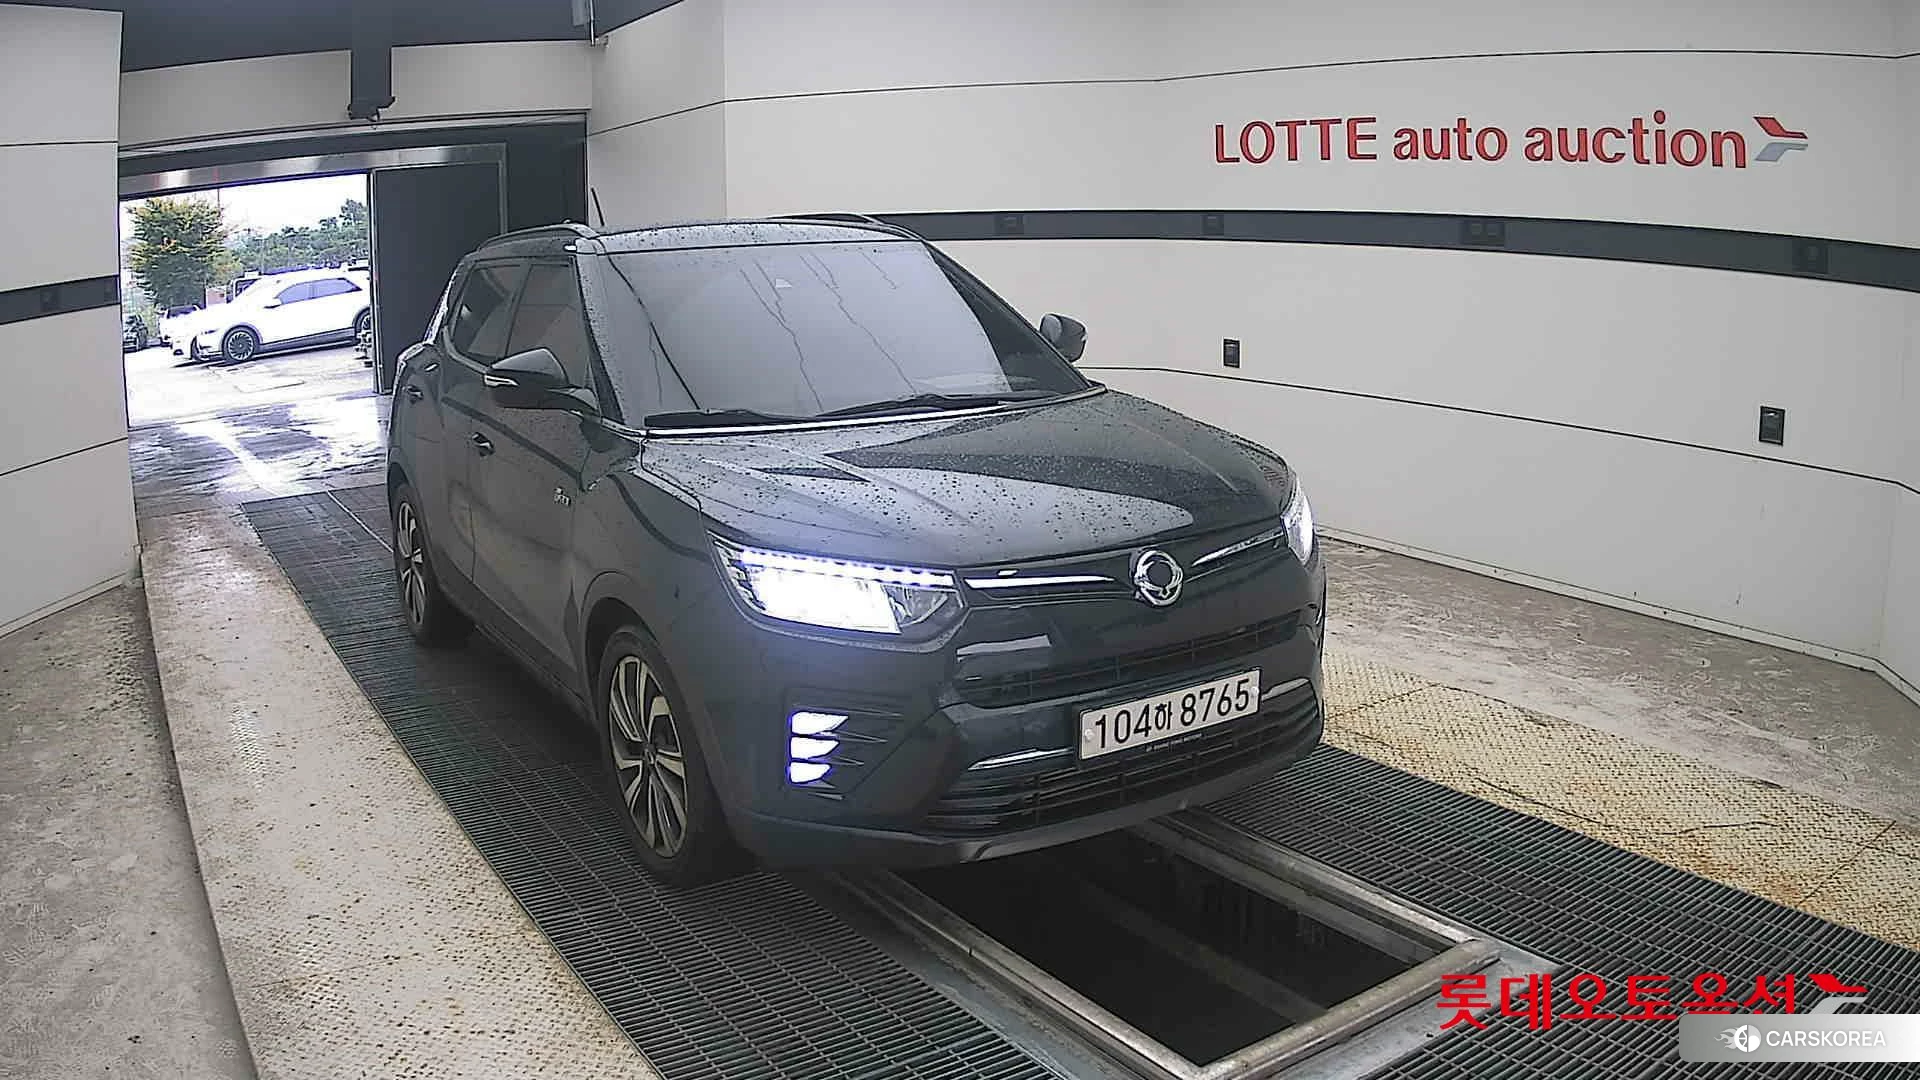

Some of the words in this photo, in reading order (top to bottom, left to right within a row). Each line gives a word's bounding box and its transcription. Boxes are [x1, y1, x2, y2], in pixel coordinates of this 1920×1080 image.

[1215, 116, 1377, 164] LOTTE
[1393, 117, 1508, 162] auto
[1523, 110, 1747, 169] auction
[1180, 678, 1250, 727] 8765
